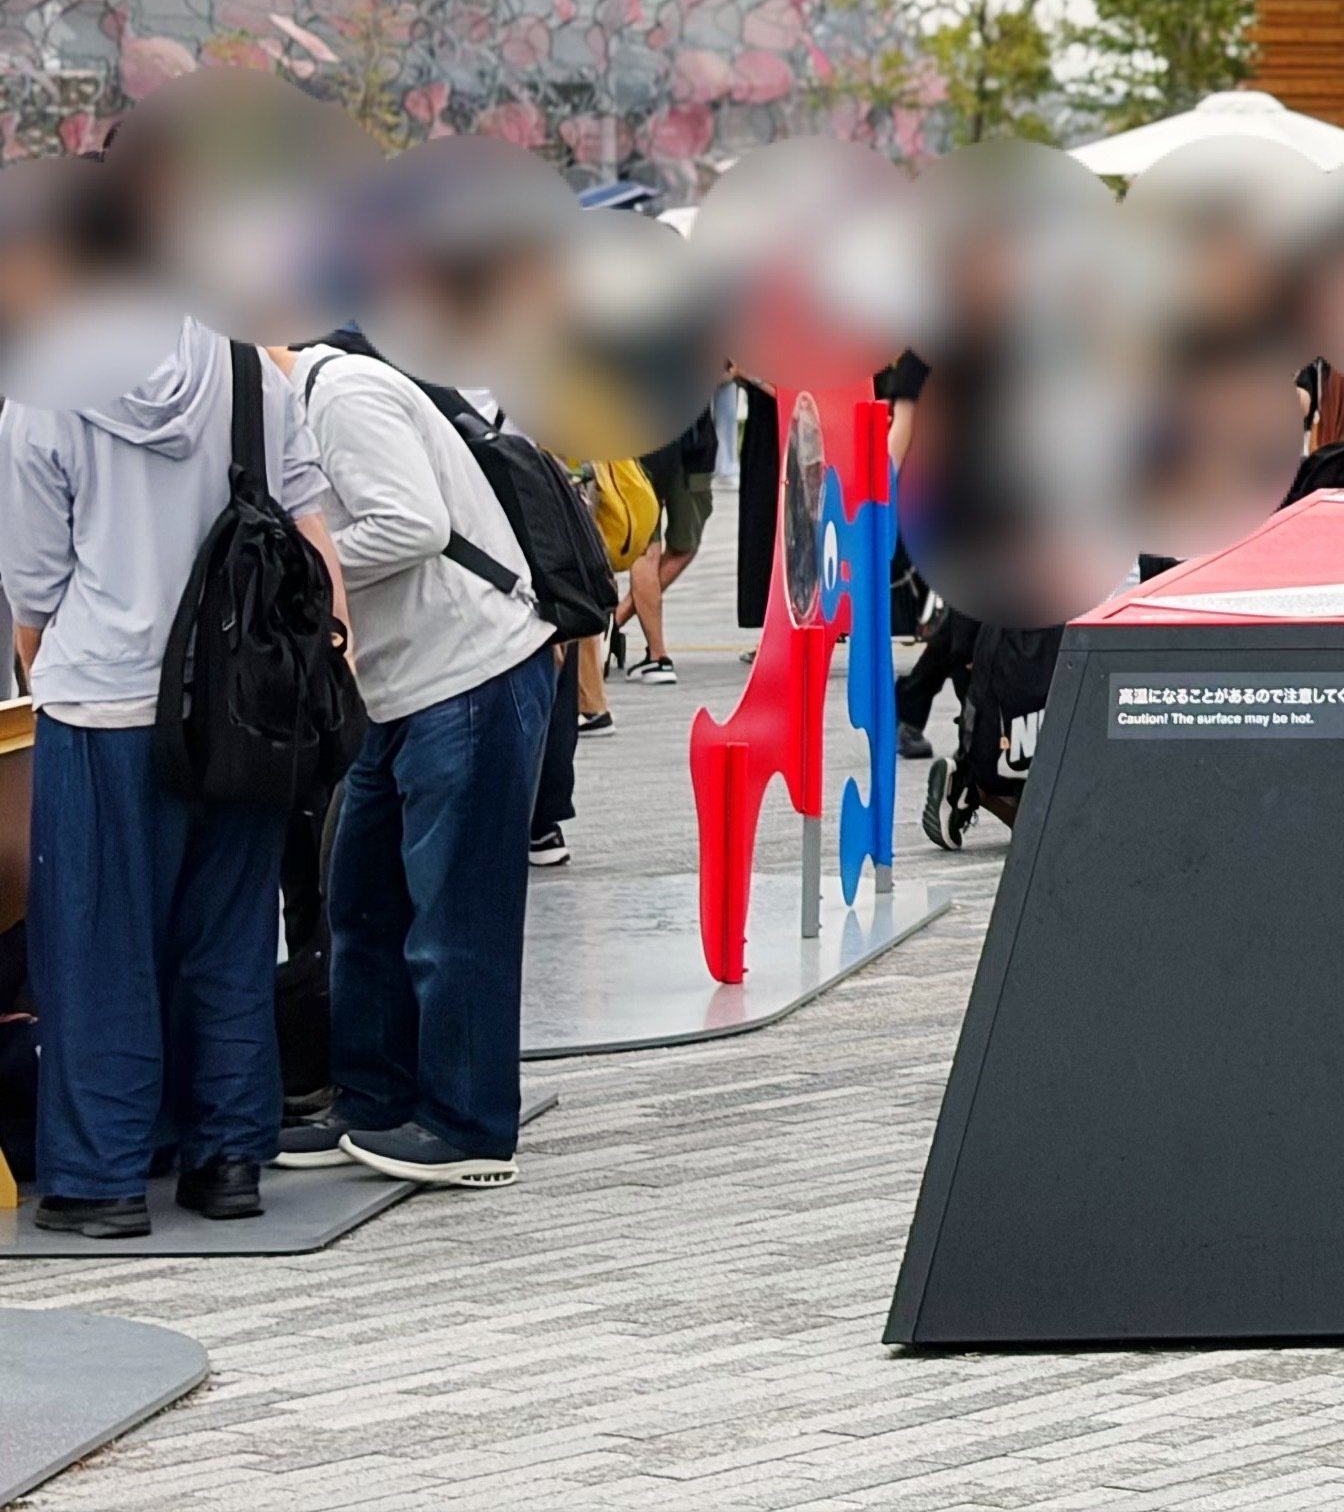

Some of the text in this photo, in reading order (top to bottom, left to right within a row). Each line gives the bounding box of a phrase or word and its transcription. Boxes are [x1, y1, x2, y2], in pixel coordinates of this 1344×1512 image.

[1118, 712, 1315, 728] Caution! The surface may be hot.
